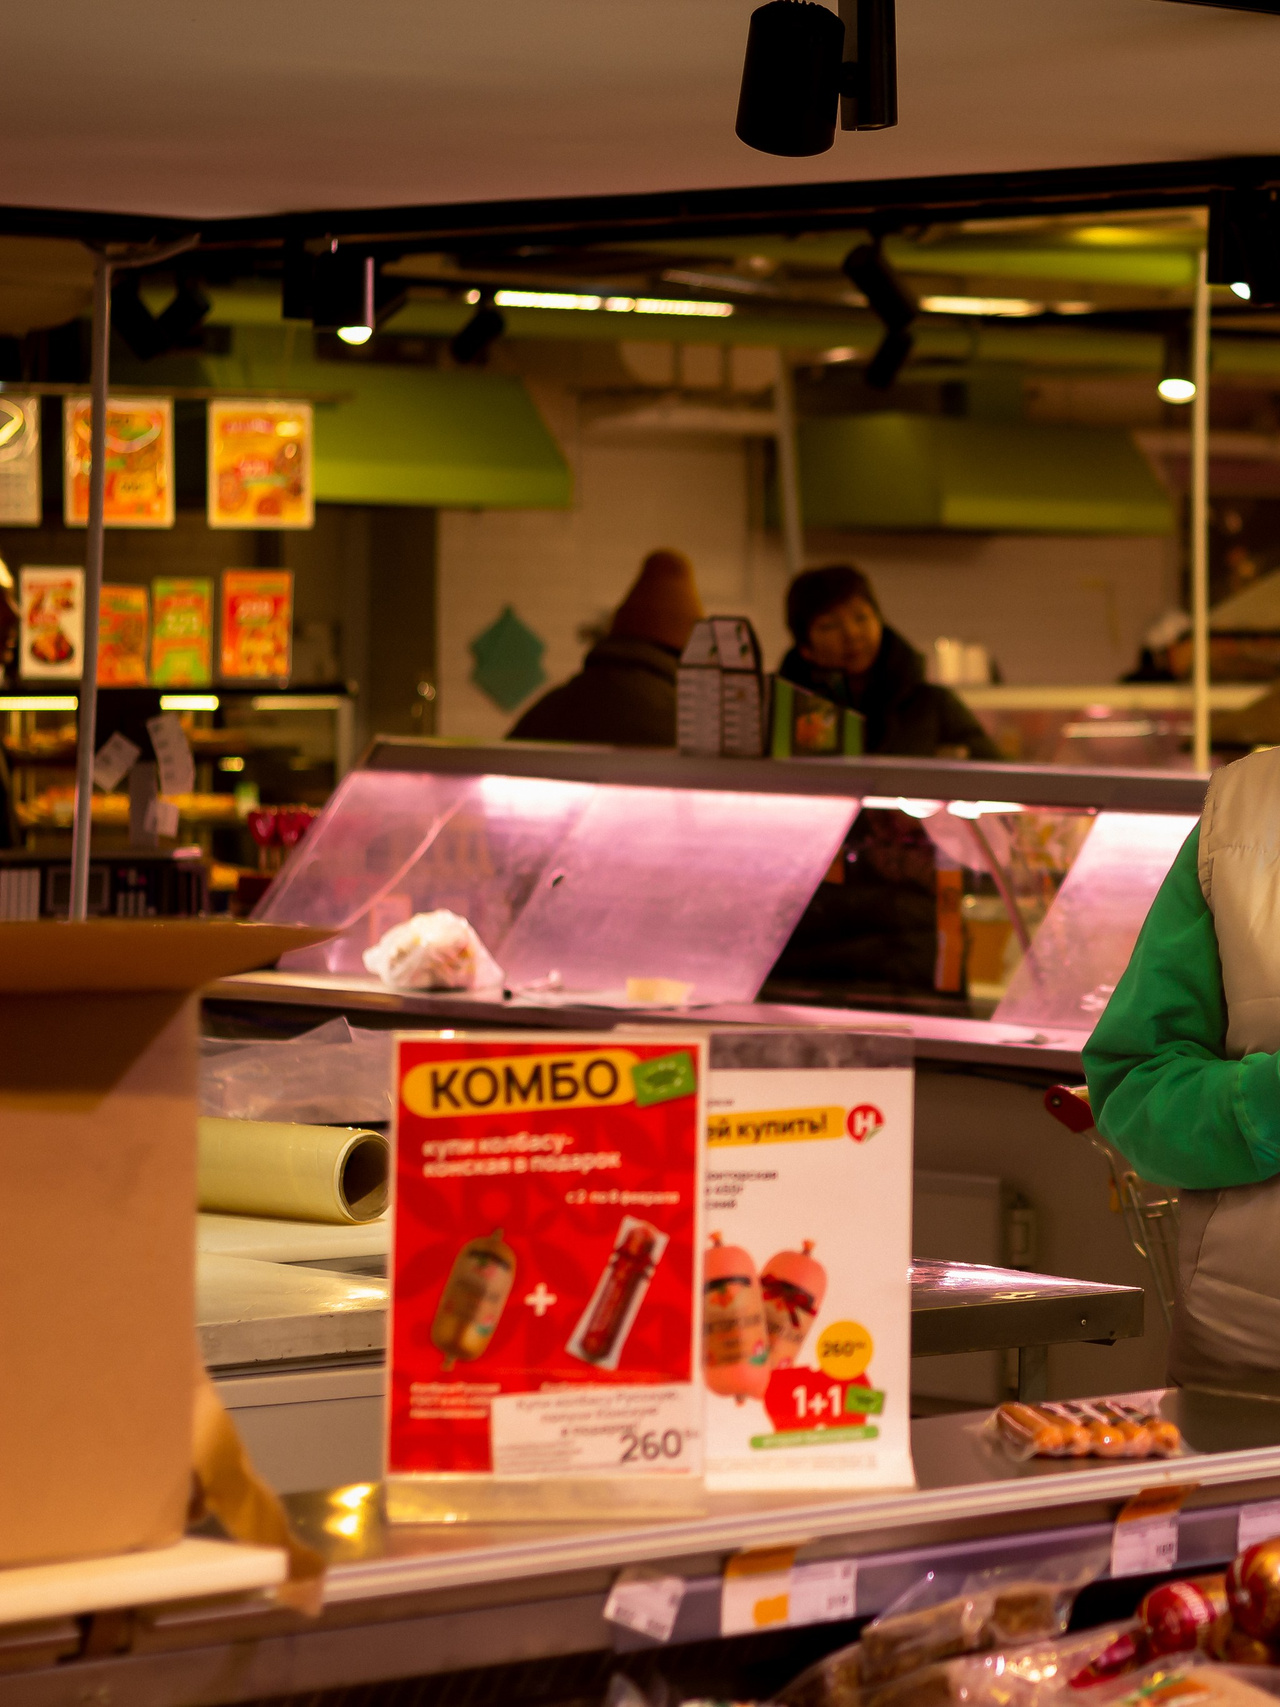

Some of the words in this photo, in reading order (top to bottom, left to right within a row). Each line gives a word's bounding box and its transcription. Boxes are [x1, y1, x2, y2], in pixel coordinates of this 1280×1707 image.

[430, 1059, 619, 1111] КОМБО
[736, 1111, 828, 1144] купить!
[822, 1340, 855, 1358] 260
[792, 1384, 842, 1418] 1+1
[619, 1429, 683, 1464] 260
